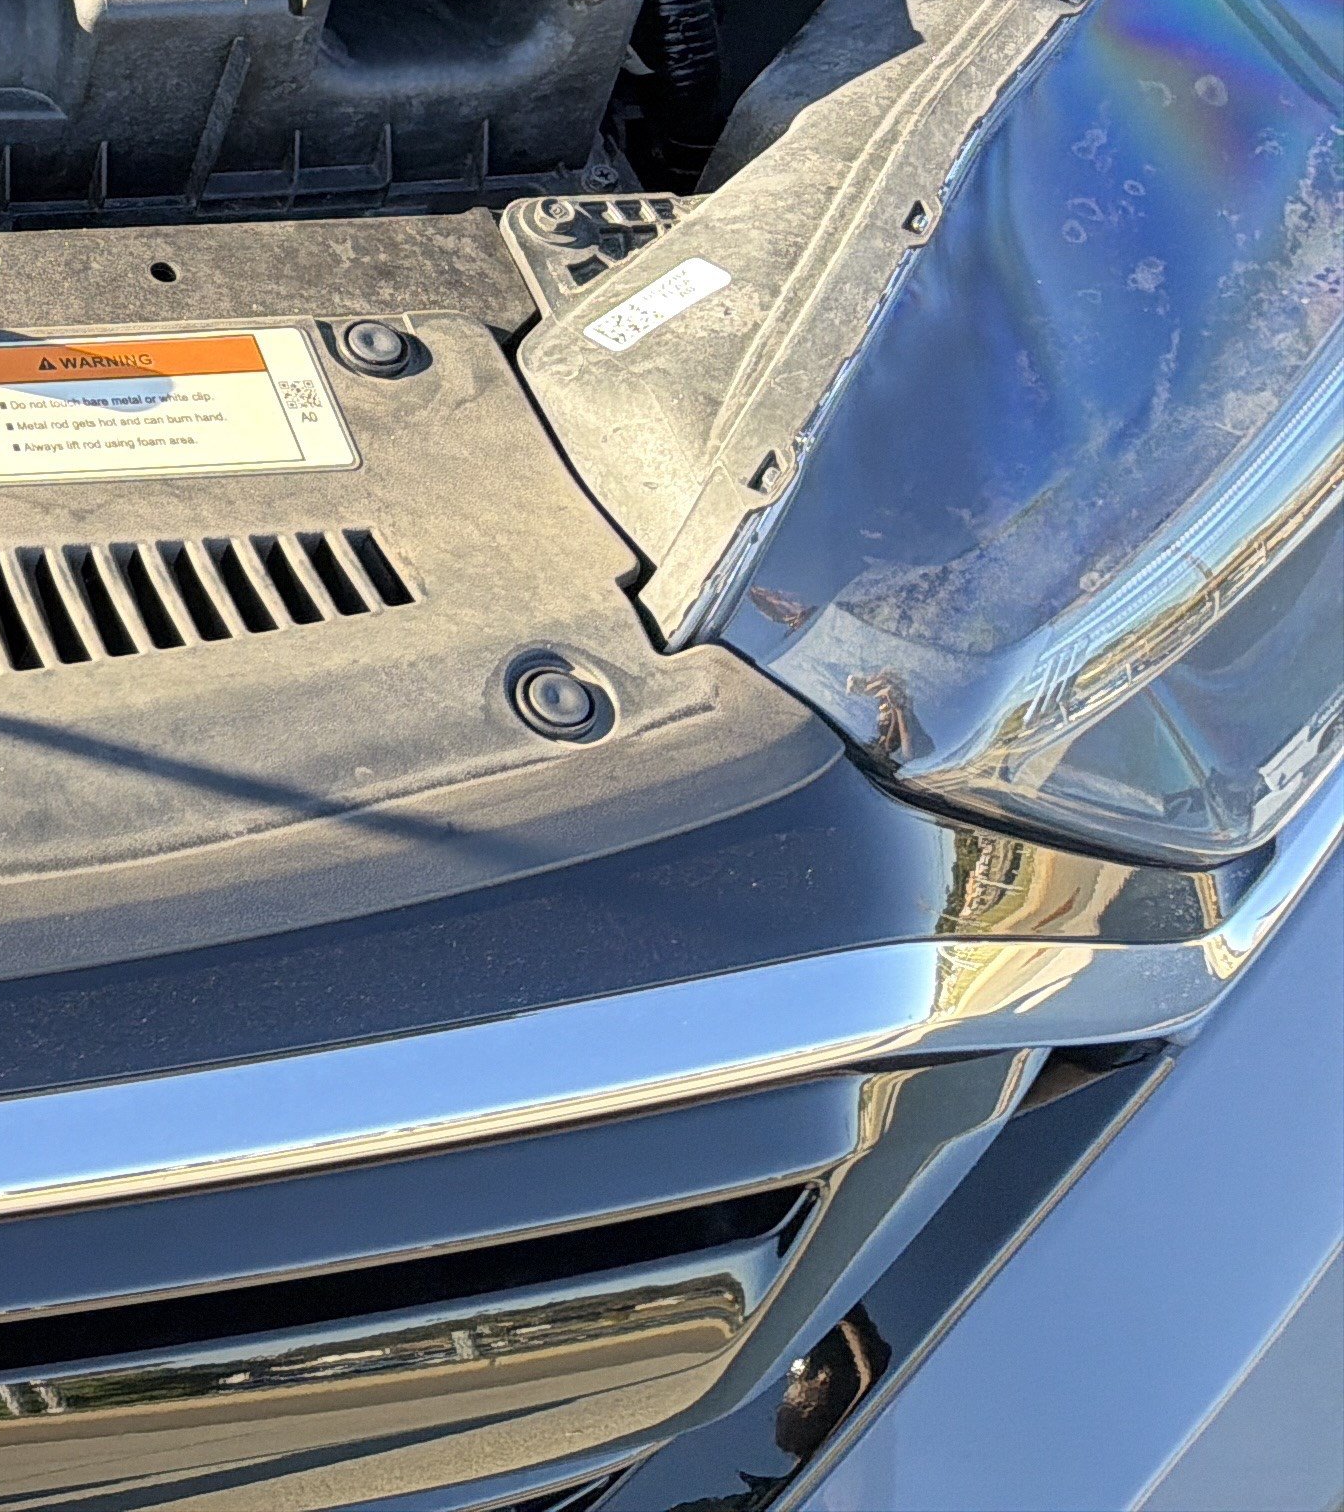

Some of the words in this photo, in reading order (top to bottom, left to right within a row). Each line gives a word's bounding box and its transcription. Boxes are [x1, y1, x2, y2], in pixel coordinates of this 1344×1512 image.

[59, 353, 153, 370] WARNING
[10, 400, 26, 411] Do
[29, 399, 47, 410] not
[50, 396, 80, 408] touch
[83, 396, 108, 407] bare
[111, 394, 142, 406] metal
[144, 395, 157, 405] or
[158, 392, 189, 404] white
[17, 420, 48, 431] Metal
[50, 418, 69, 430] rod
[72, 418, 96, 431] gets
[98, 416, 118, 428] hot
[120, 415, 141, 427] and
[143, 415, 164, 425] can
[166, 412, 193, 424] burn
[195, 411, 228, 424] hand.
[24, 441, 64, 454] Always
[66, 439, 81, 451] lift
[82, 438, 102, 450] rod
[104, 437, 136, 451] using
[137, 435, 166, 447] foam
[168, 435, 199, 446] area.
